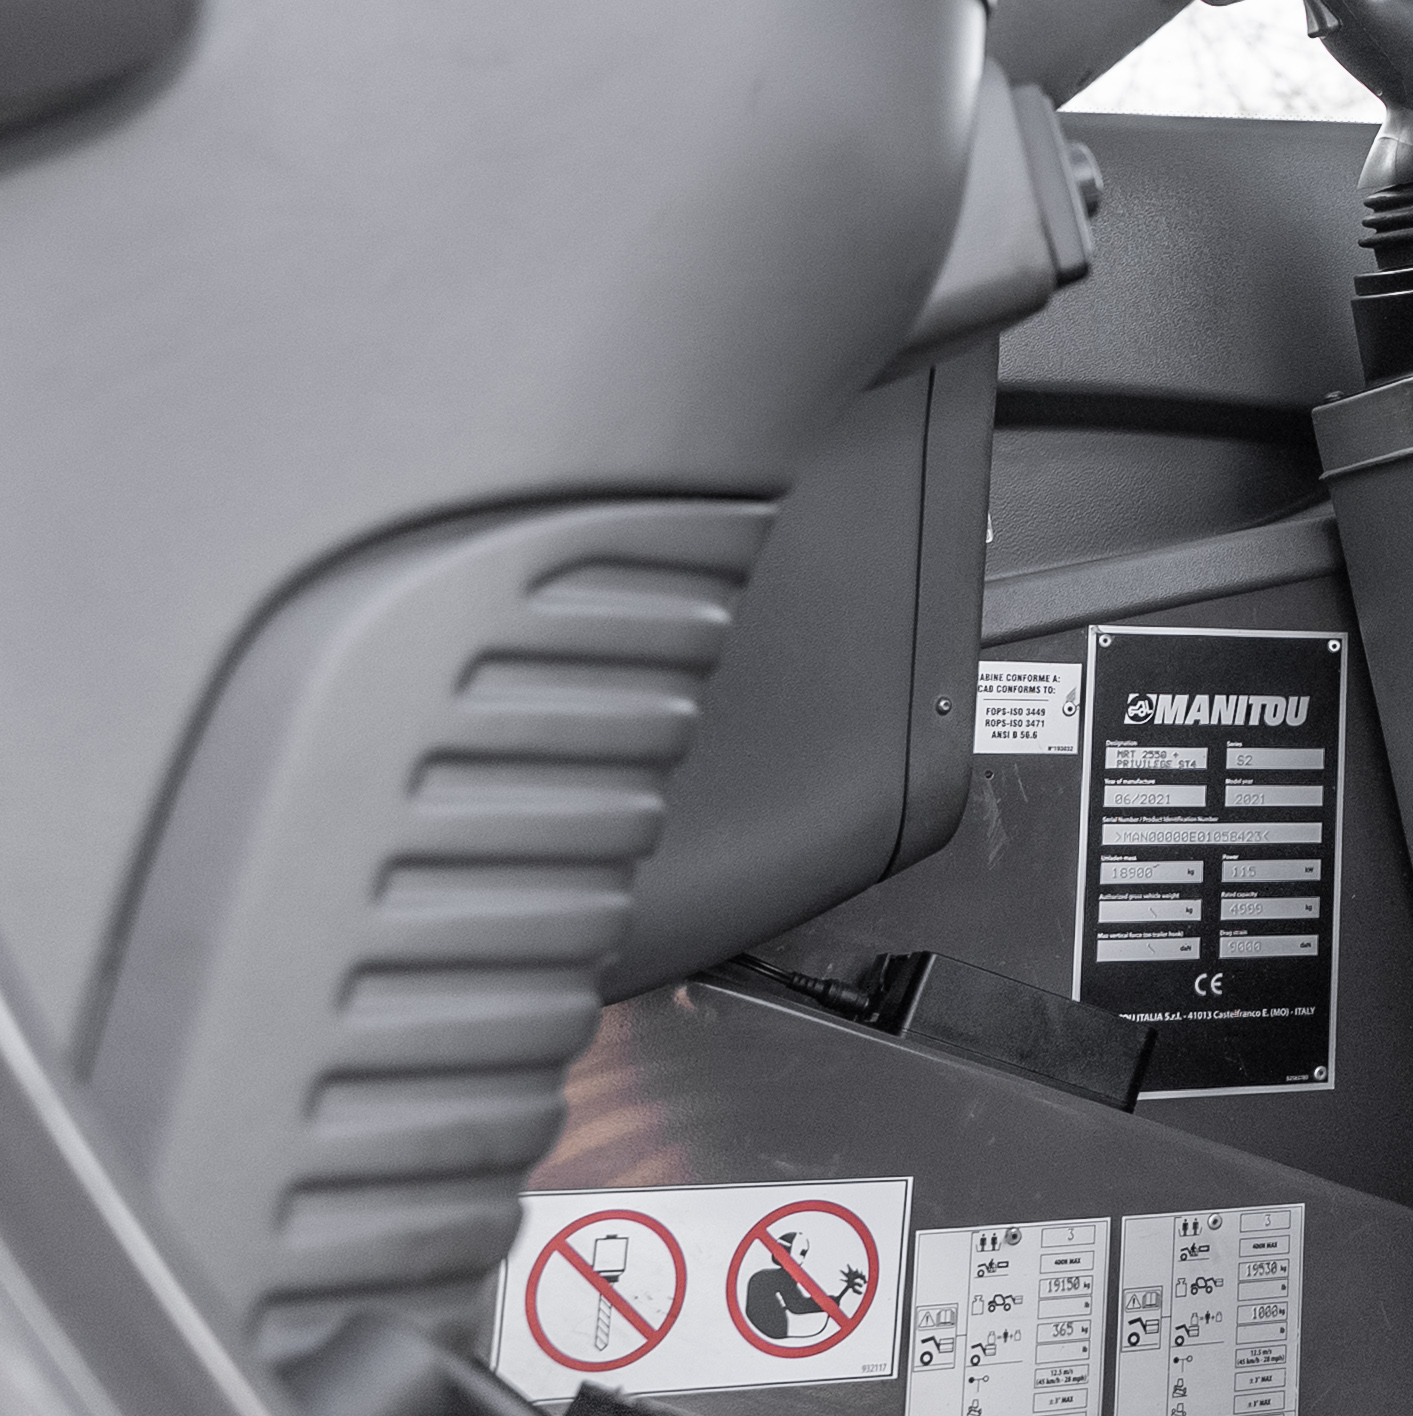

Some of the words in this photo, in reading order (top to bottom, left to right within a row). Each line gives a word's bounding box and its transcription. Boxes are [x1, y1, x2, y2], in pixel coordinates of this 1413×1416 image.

[979, 673, 1004, 682] ABINE
[1006, 673, 1050, 683] CONFORME
[996, 685, 1041, 694] CONFORMS
[1043, 686, 1056, 694] TO:
[986, 707, 1024, 716] FOPS-ISO
[1025, 708, 1046, 716] 3449
[1154, 694, 1310, 726] MANITOU
[985, 719, 1023, 727] ROPS-ISO
[1025, 719, 1045, 727] 3471
[991, 730, 1010, 739] ANSI
[1116, 750, 1136, 758] MRT
[1236, 755, 1253, 766] S2
[1114, 793, 1171, 805] 06/2021
[1234, 794, 1265, 805] 2021
[1111, 867, 1153, 879] 18900
[1232, 865, 1257, 878] 115
[1194, 973, 1223, 996] CE
[1136, 1012, 1163, 1022] ITALIA
[1188, 1011, 1212, 1020] 41013
[1213, 1009, 1261, 1019] Castelfranco
[1270, 1007, 1289, 1017] (MO)
[1294, 1006, 1316, 1015] ITALY
[1067, 1227, 1074, 1241] 3
[1048, 1277, 1080, 1293] 19150
[1052, 1321, 1074, 1337] 365
